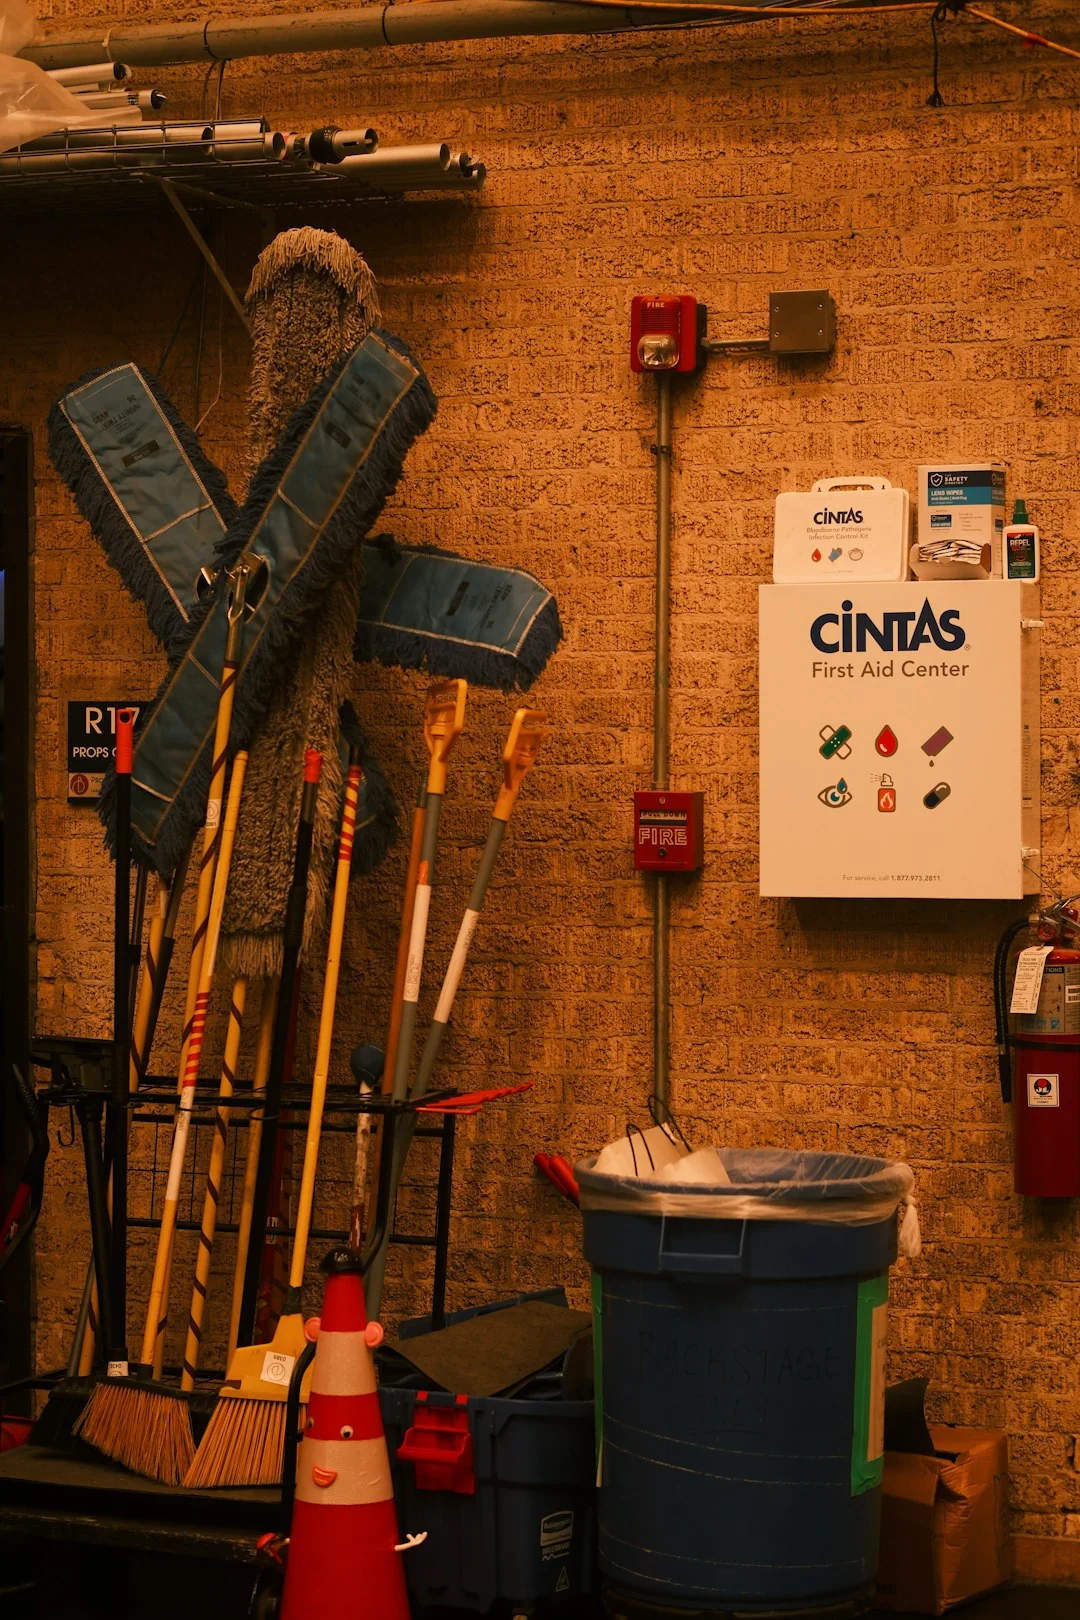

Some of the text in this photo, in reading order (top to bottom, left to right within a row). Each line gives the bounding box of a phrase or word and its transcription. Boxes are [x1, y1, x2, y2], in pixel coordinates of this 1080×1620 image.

[1009, 539, 1031, 547] REPEL
[813, 659, 970, 678] First Aid Center
[85, 706, 140, 734] R17
[72, 746, 109, 758] PROPS
[639, 828, 687, 845] FIRE
